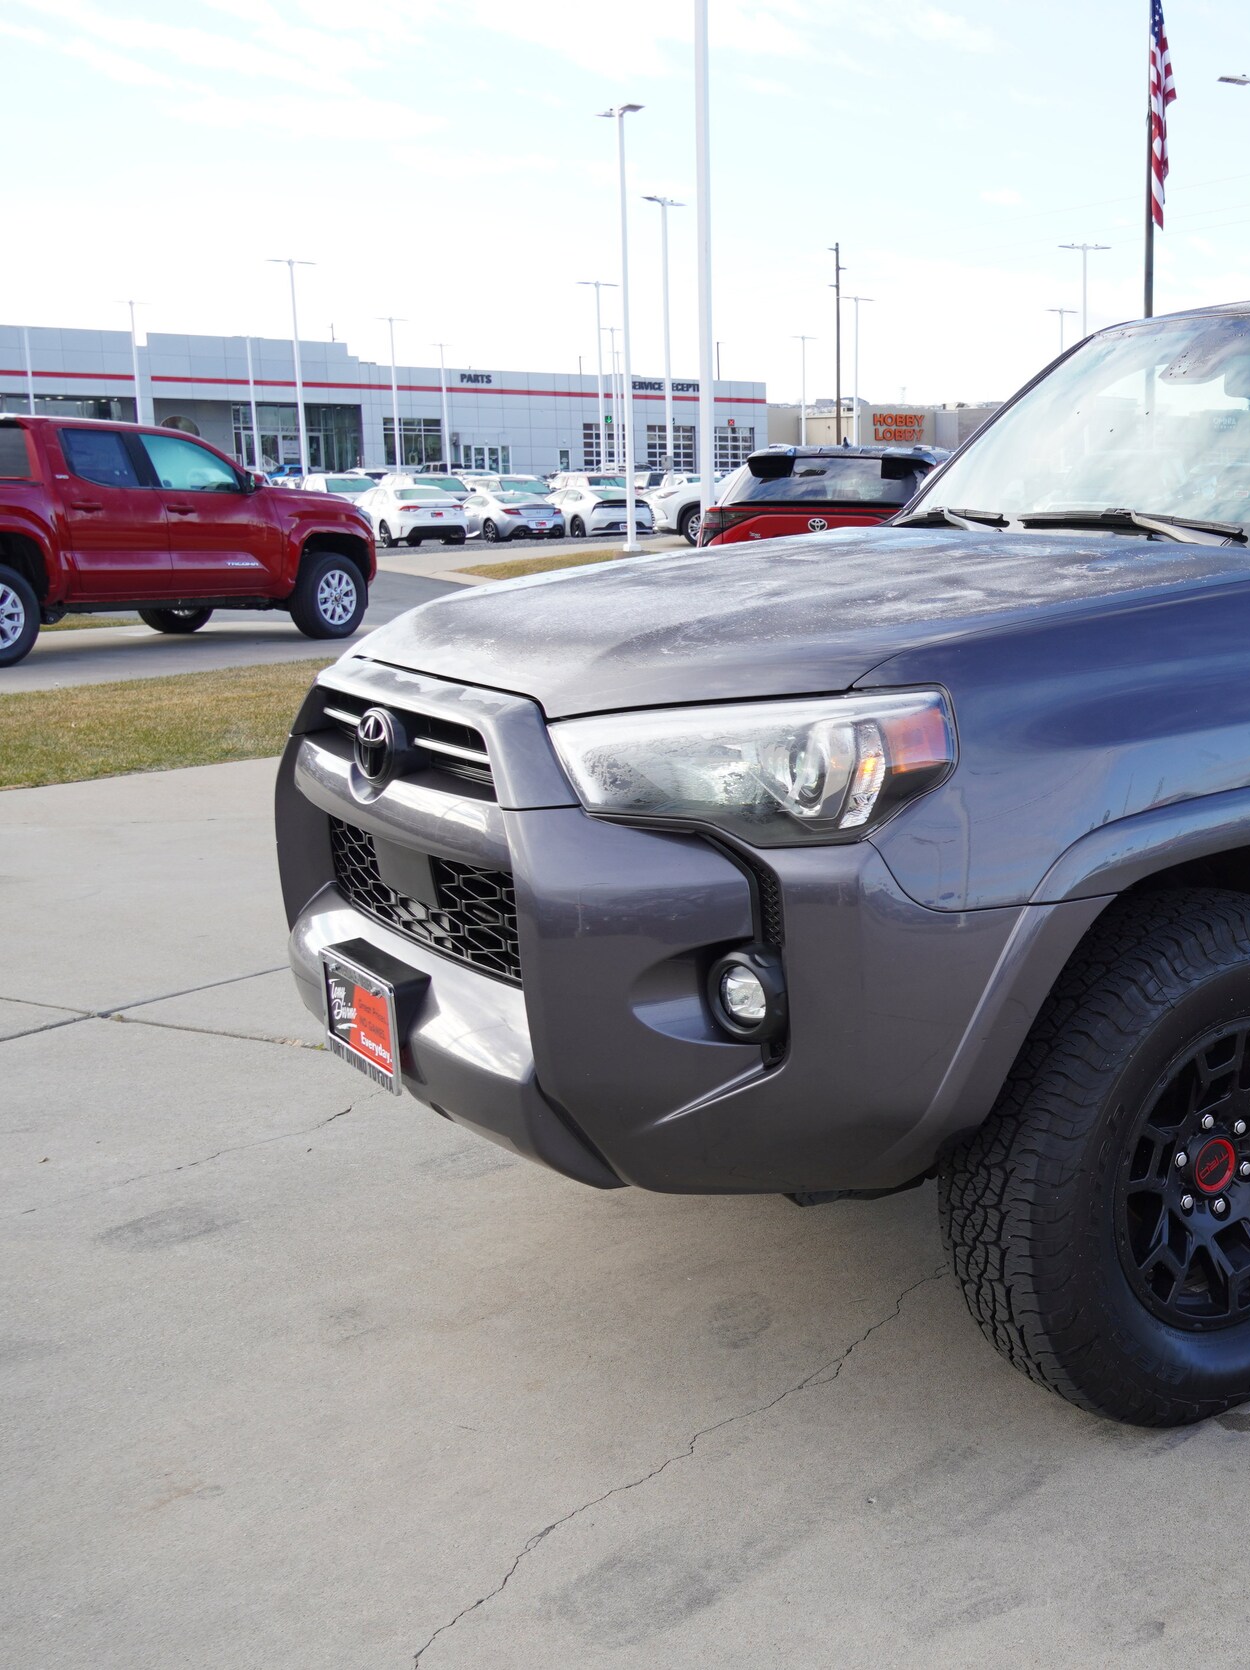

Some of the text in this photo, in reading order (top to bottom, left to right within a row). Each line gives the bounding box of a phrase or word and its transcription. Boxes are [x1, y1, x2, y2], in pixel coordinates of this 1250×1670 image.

[460, 373, 492, 384] PARTS
[671, 383, 700, 392] ECEPTI
[872, 413, 925, 427] HOBBY
[874, 427, 924, 441] LOBBY
